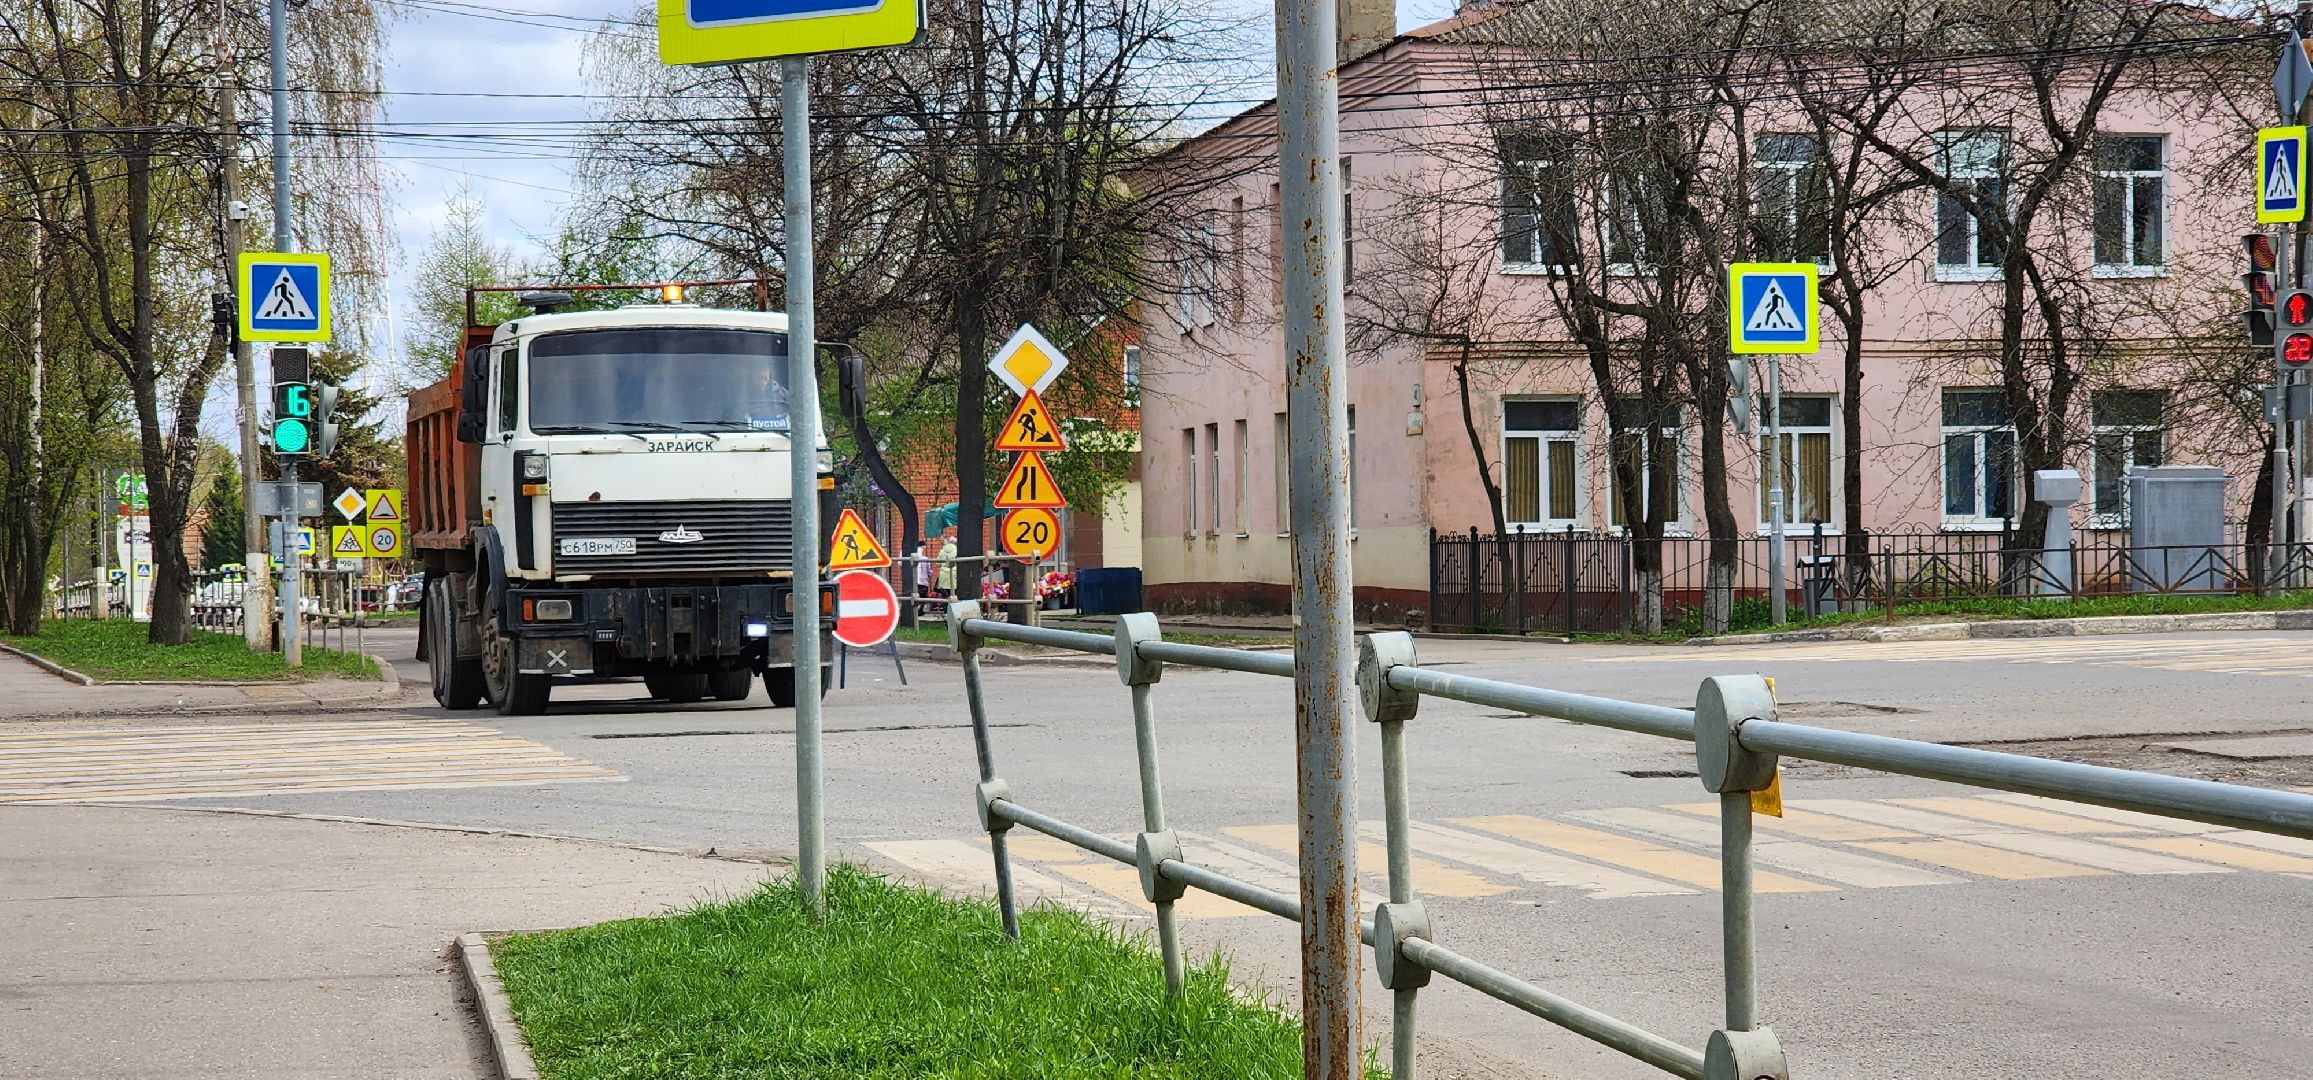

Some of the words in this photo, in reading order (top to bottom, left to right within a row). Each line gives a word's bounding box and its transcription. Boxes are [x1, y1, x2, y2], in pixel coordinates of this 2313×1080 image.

[2284, 337, 2312, 361] 22
[288, 385, 309, 416] 16
[377, 534, 392, 545] 20
[1016, 521, 1048, 544] 20
